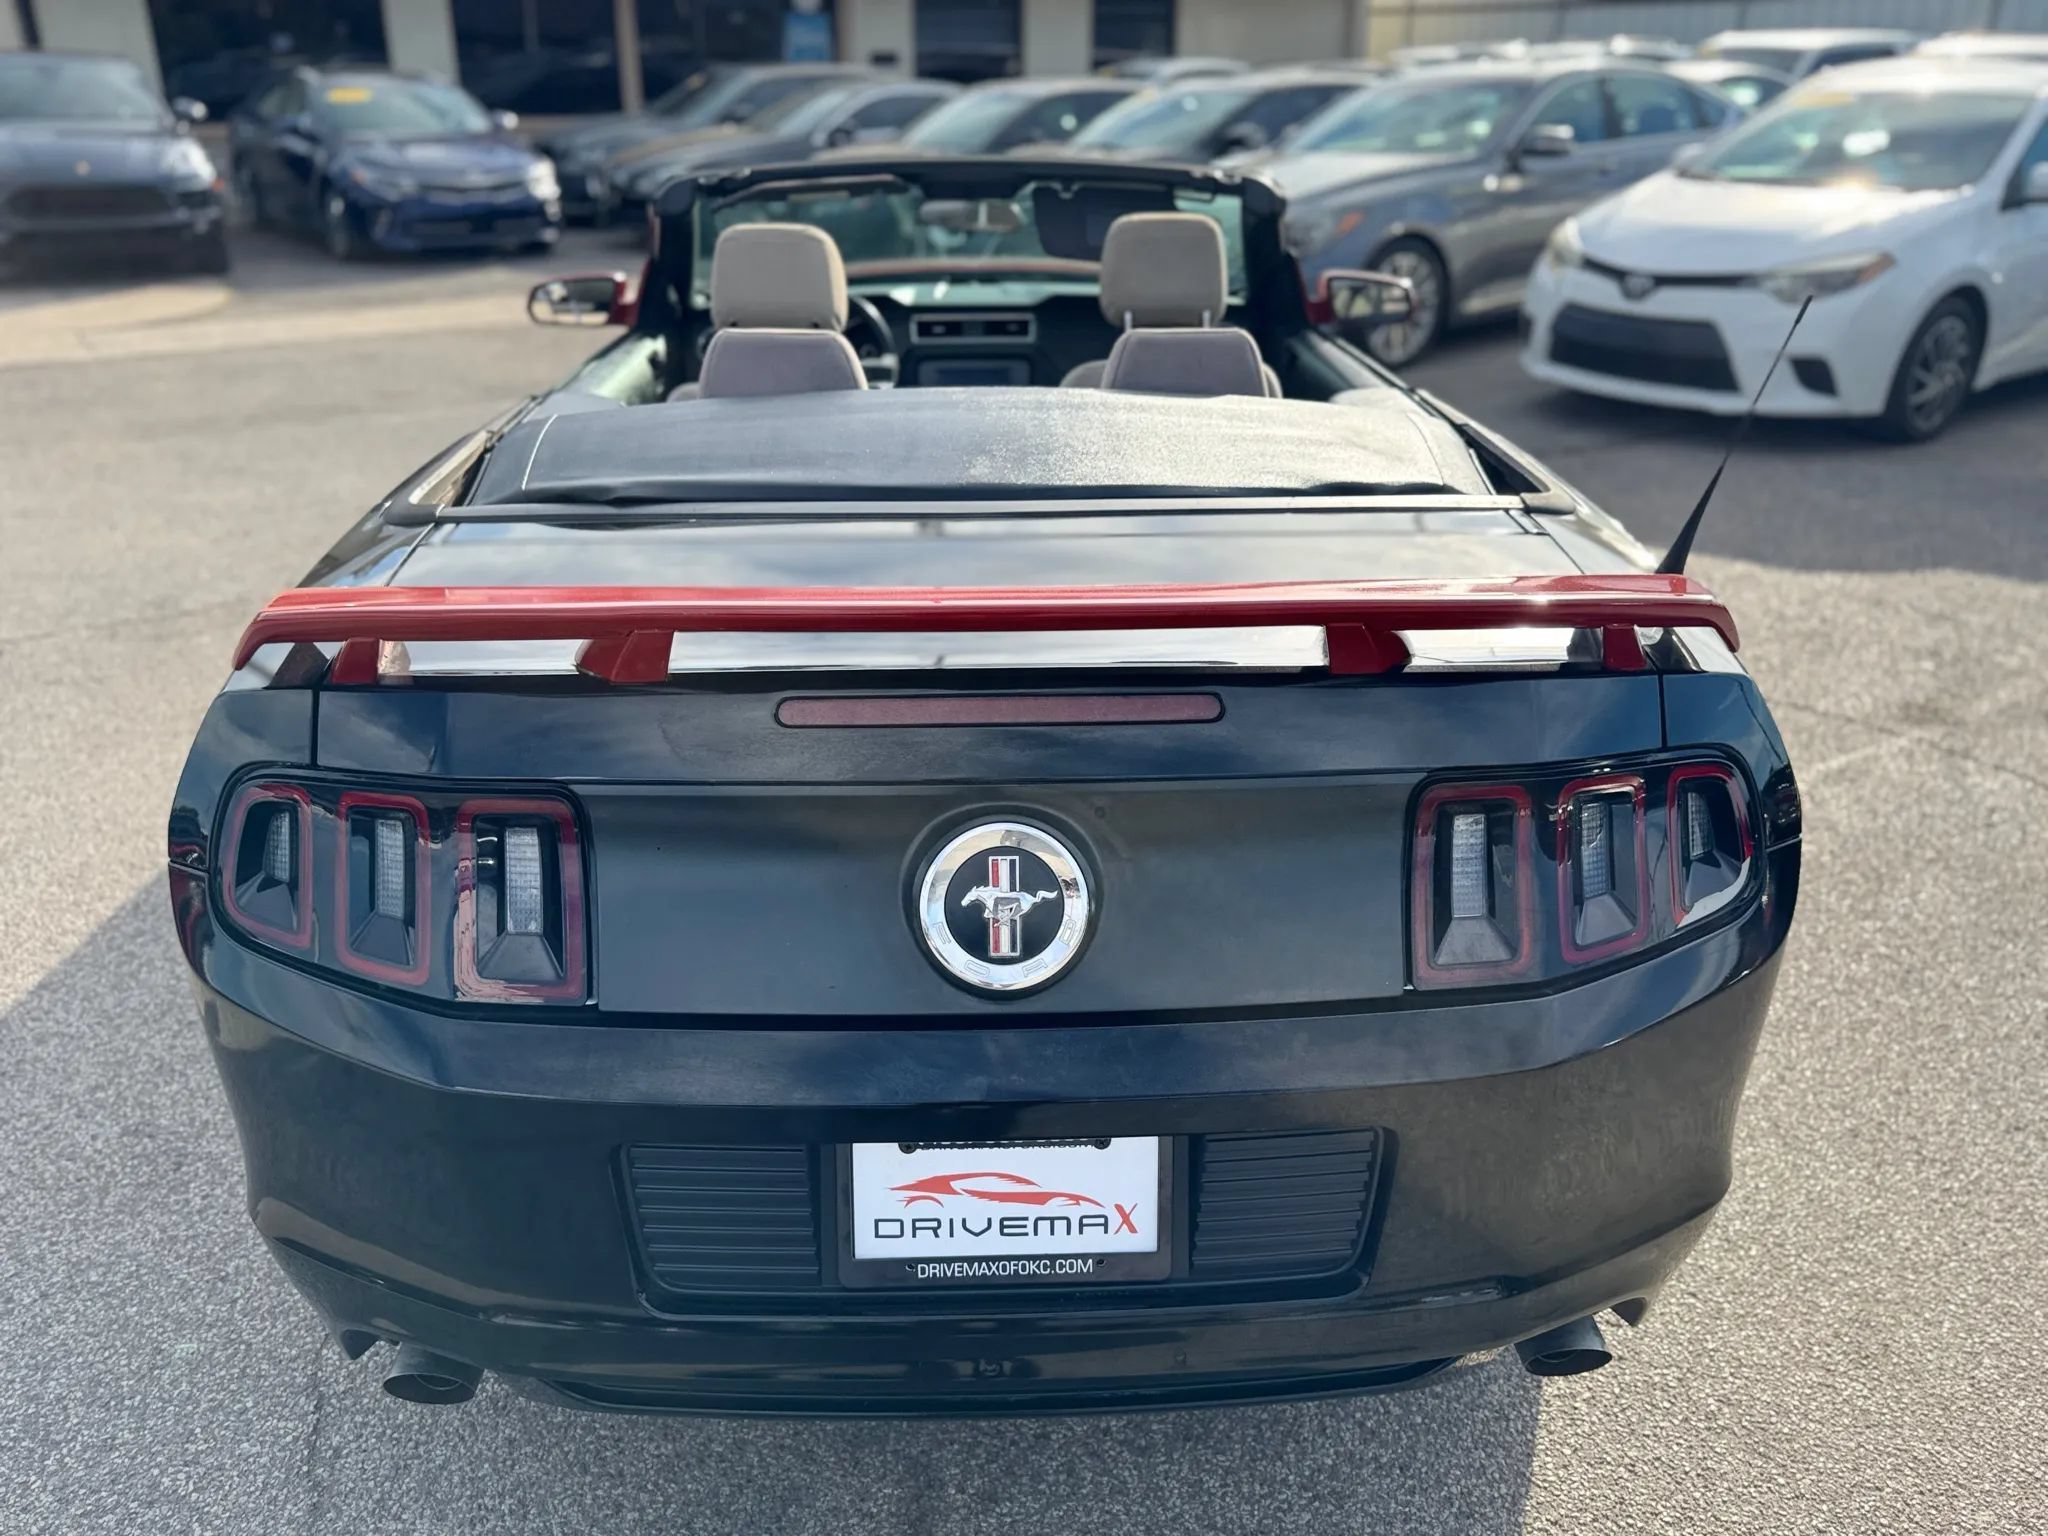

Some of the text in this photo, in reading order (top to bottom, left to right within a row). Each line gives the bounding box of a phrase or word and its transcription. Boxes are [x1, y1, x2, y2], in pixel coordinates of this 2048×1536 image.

[932, 918, 1078, 978] FORD
[873, 1202, 1139, 1239] DRIVEMAX
[917, 1258, 1094, 1279] DRIVEMAXOFOKC.COM
